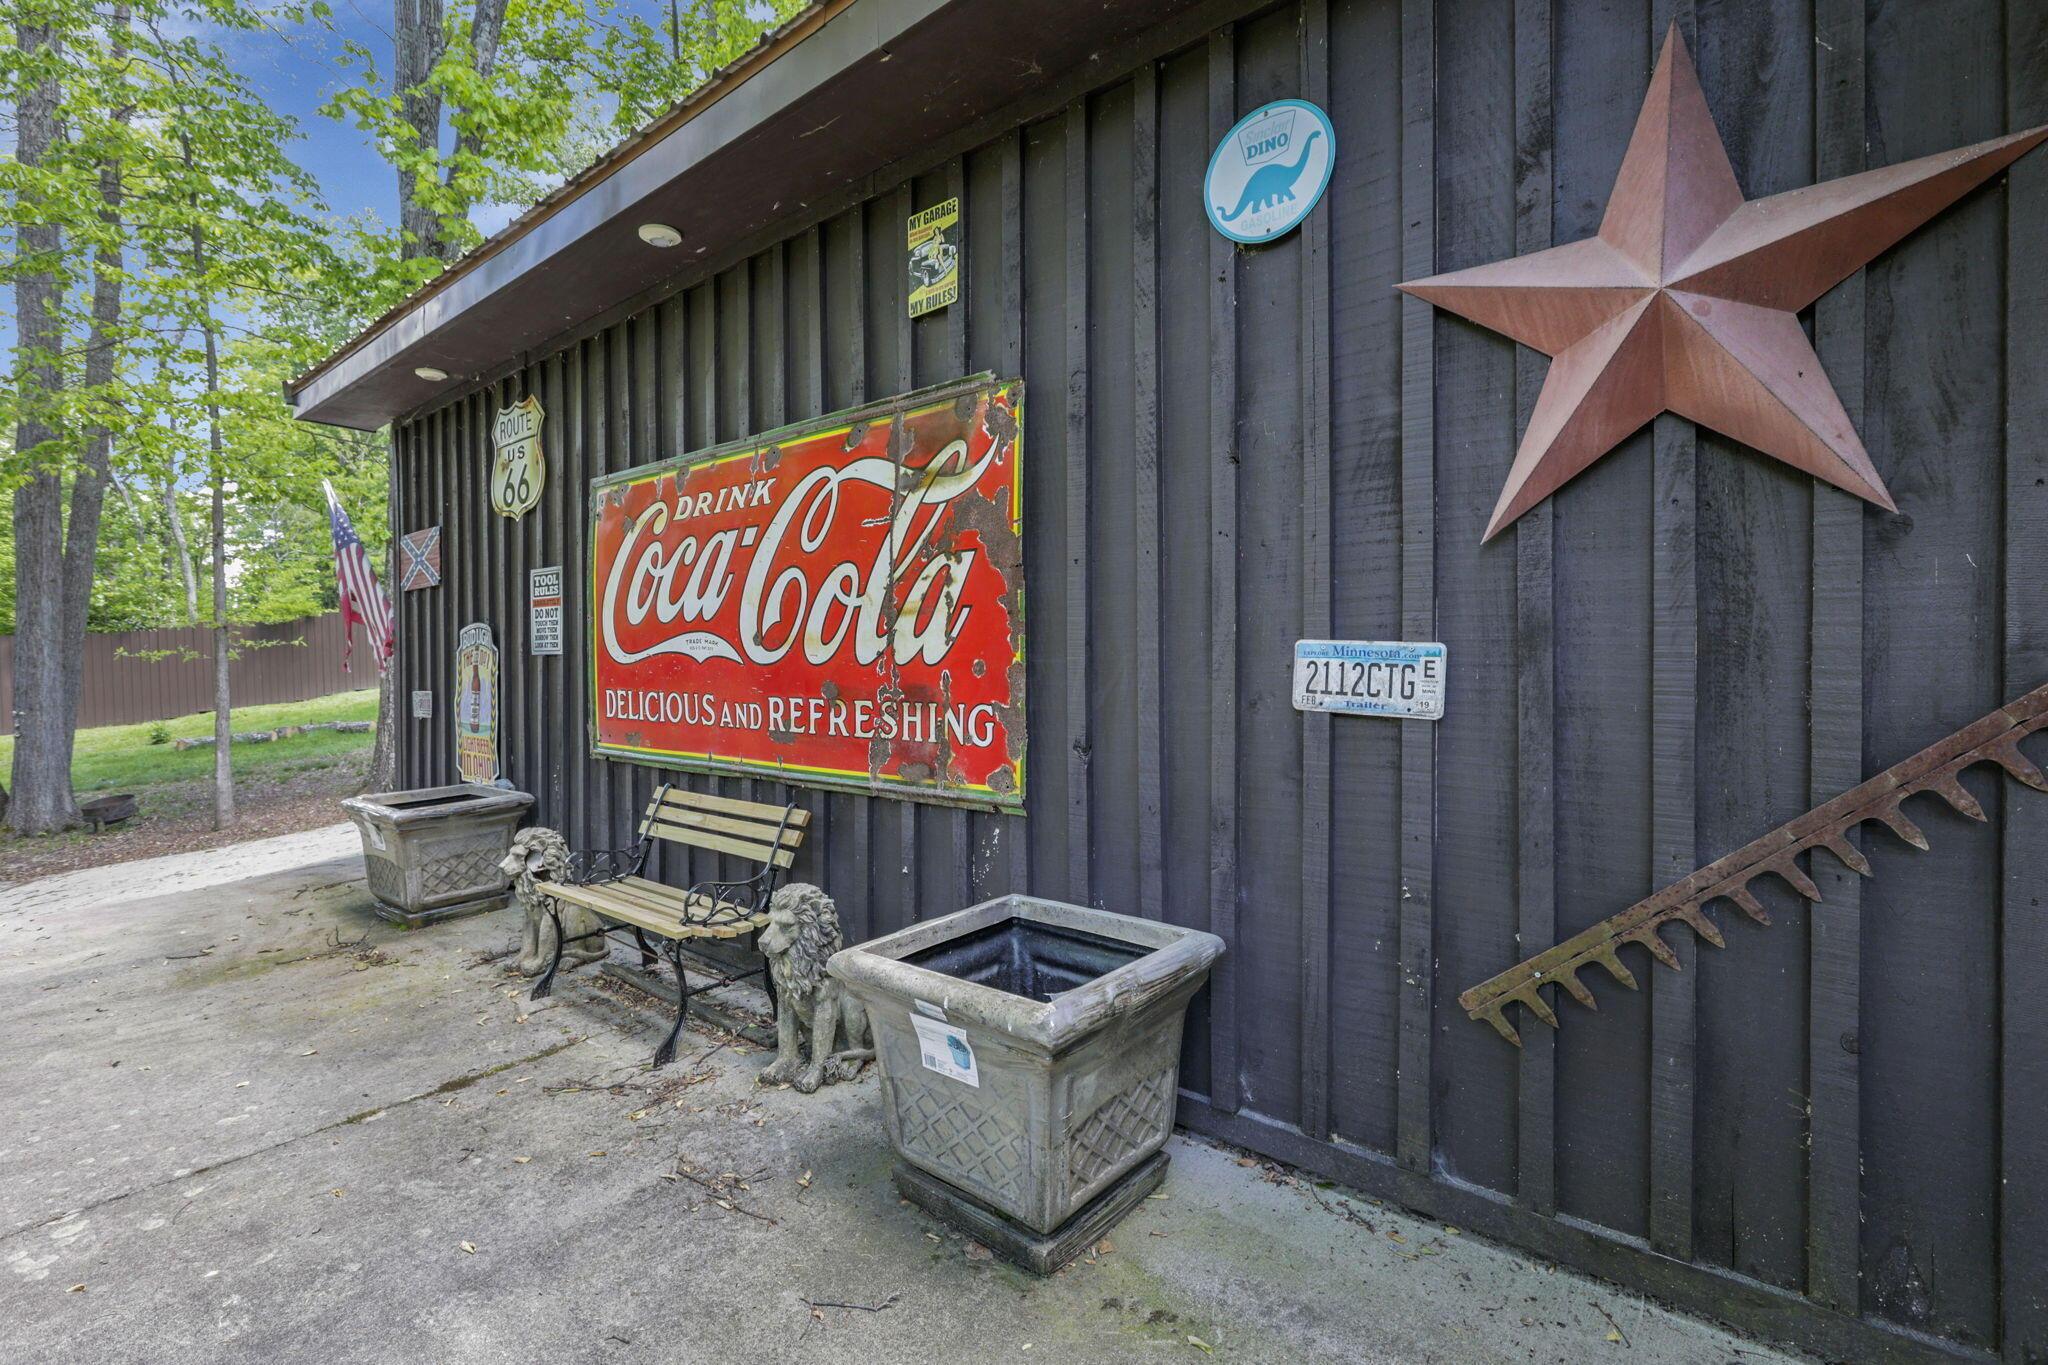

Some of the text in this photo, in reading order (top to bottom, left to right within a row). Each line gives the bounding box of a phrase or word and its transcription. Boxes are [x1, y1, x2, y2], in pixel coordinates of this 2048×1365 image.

[1246, 132, 1289, 161] DINO
[909, 199, 957, 232] MY GARAGE
[910, 299, 924, 317] MY
[925, 286, 956, 310] RULES!
[500, 411, 532, 440] ROUTE
[508, 445, 525, 462] US
[503, 464, 530, 508] 66
[673, 478, 777, 522] DRINK
[602, 433, 1001, 666] Coca-Cola
[534, 574, 558, 587] TOOL
[534, 586, 559, 596] RULES
[535, 607, 559, 619] DO NOT
[1305, 660, 1416, 700] 2112CTG
[1424, 660, 1436, 678] E
[605, 688, 995, 749] DELICIOUS AND REFRESHING
[1343, 700, 1388, 710] Trailer
[1419, 701, 1430, 709] 19
[472, 753, 492, 780] OHIO
